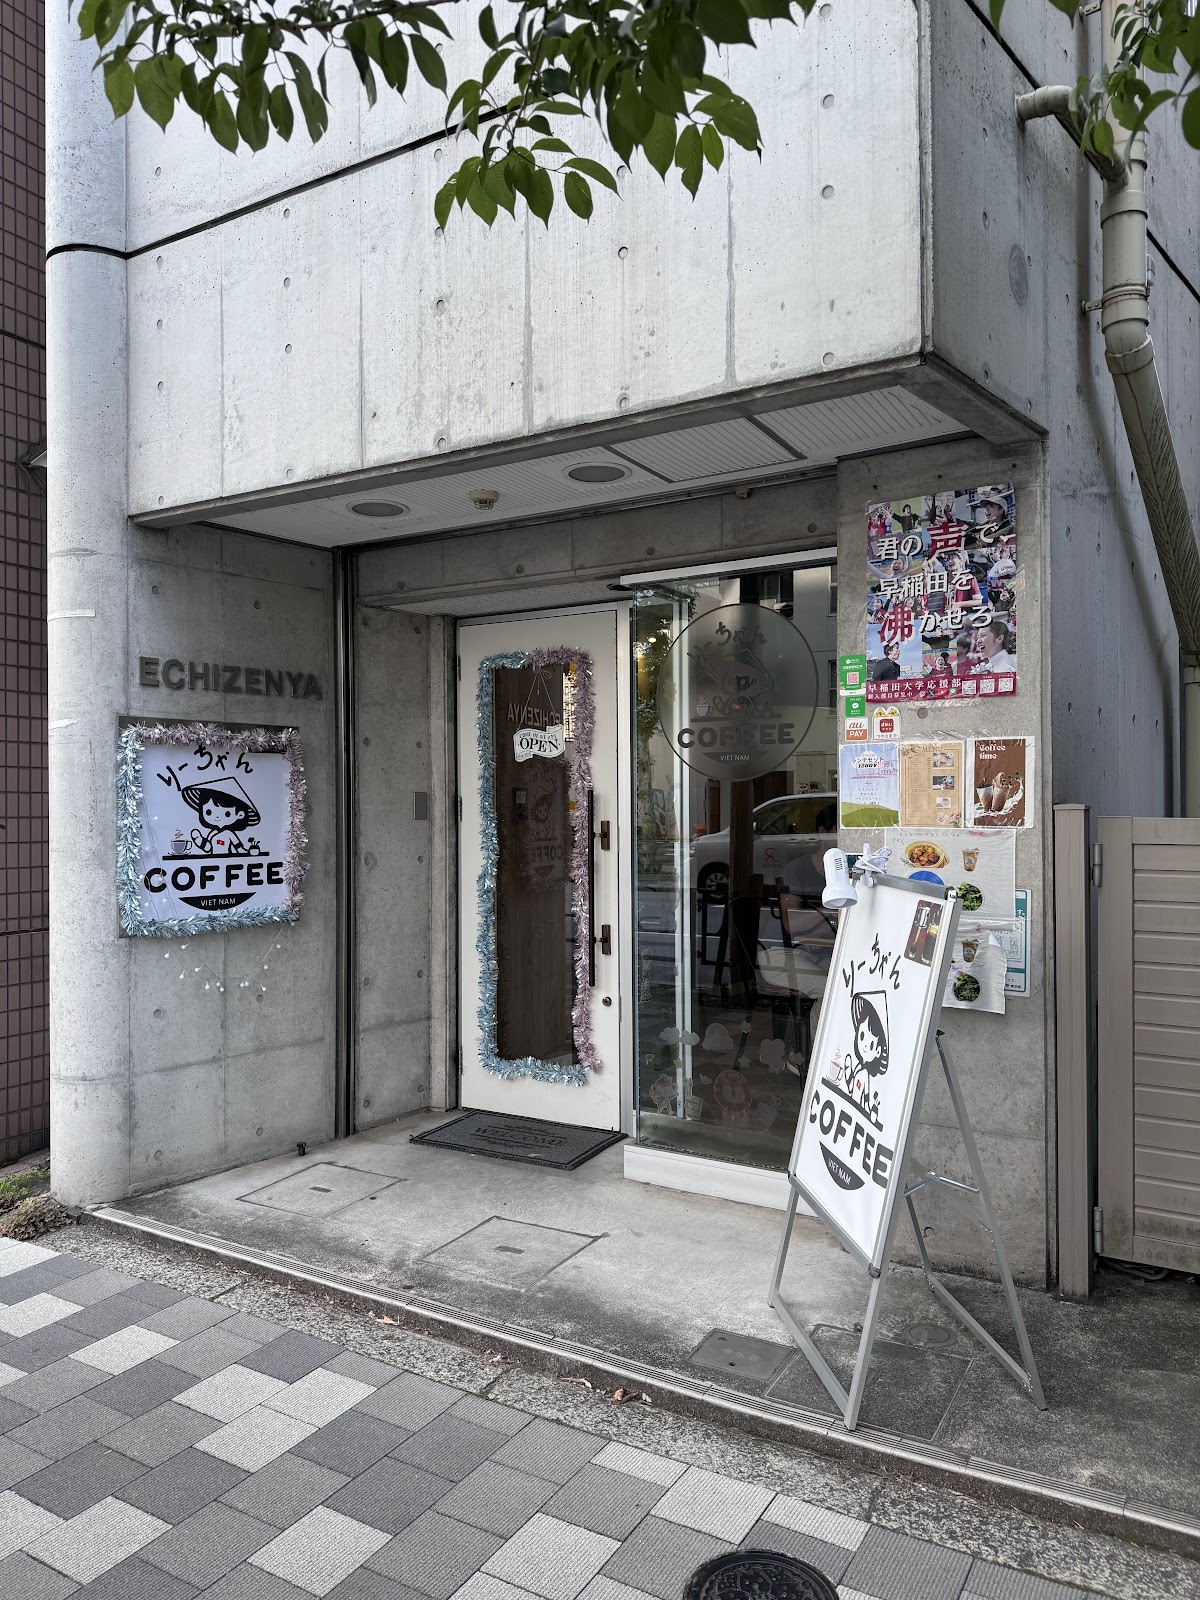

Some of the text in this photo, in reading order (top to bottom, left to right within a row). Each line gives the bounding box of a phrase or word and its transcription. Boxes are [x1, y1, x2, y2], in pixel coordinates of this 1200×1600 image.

[876, 520, 1000, 561] 君の声で
[877, 567, 974, 600] 早稲田を
[877, 605, 994, 646] 沸かせろ
[686, 621, 767, 667] りーちゃん
[138, 656, 322, 700] ECHIZENYA
[868, 677, 962, 693] 早稲田大学応援部
[519, 737, 559, 753] OPEN
[677, 722, 796, 749] COFFEE
[849, 730, 864, 738] PAY
[979, 743, 1006, 751] Coffee
[156, 745, 254, 792] りーちゃん
[979, 751, 998, 760] time
[143, 861, 285, 893] COFFEE
[200, 897, 236, 907] VIET NAM
[842, 932, 902, 998] りーちゃん
[809, 1089, 894, 1189] COFFEE
[828, 1158, 852, 1186] VIET NAM
